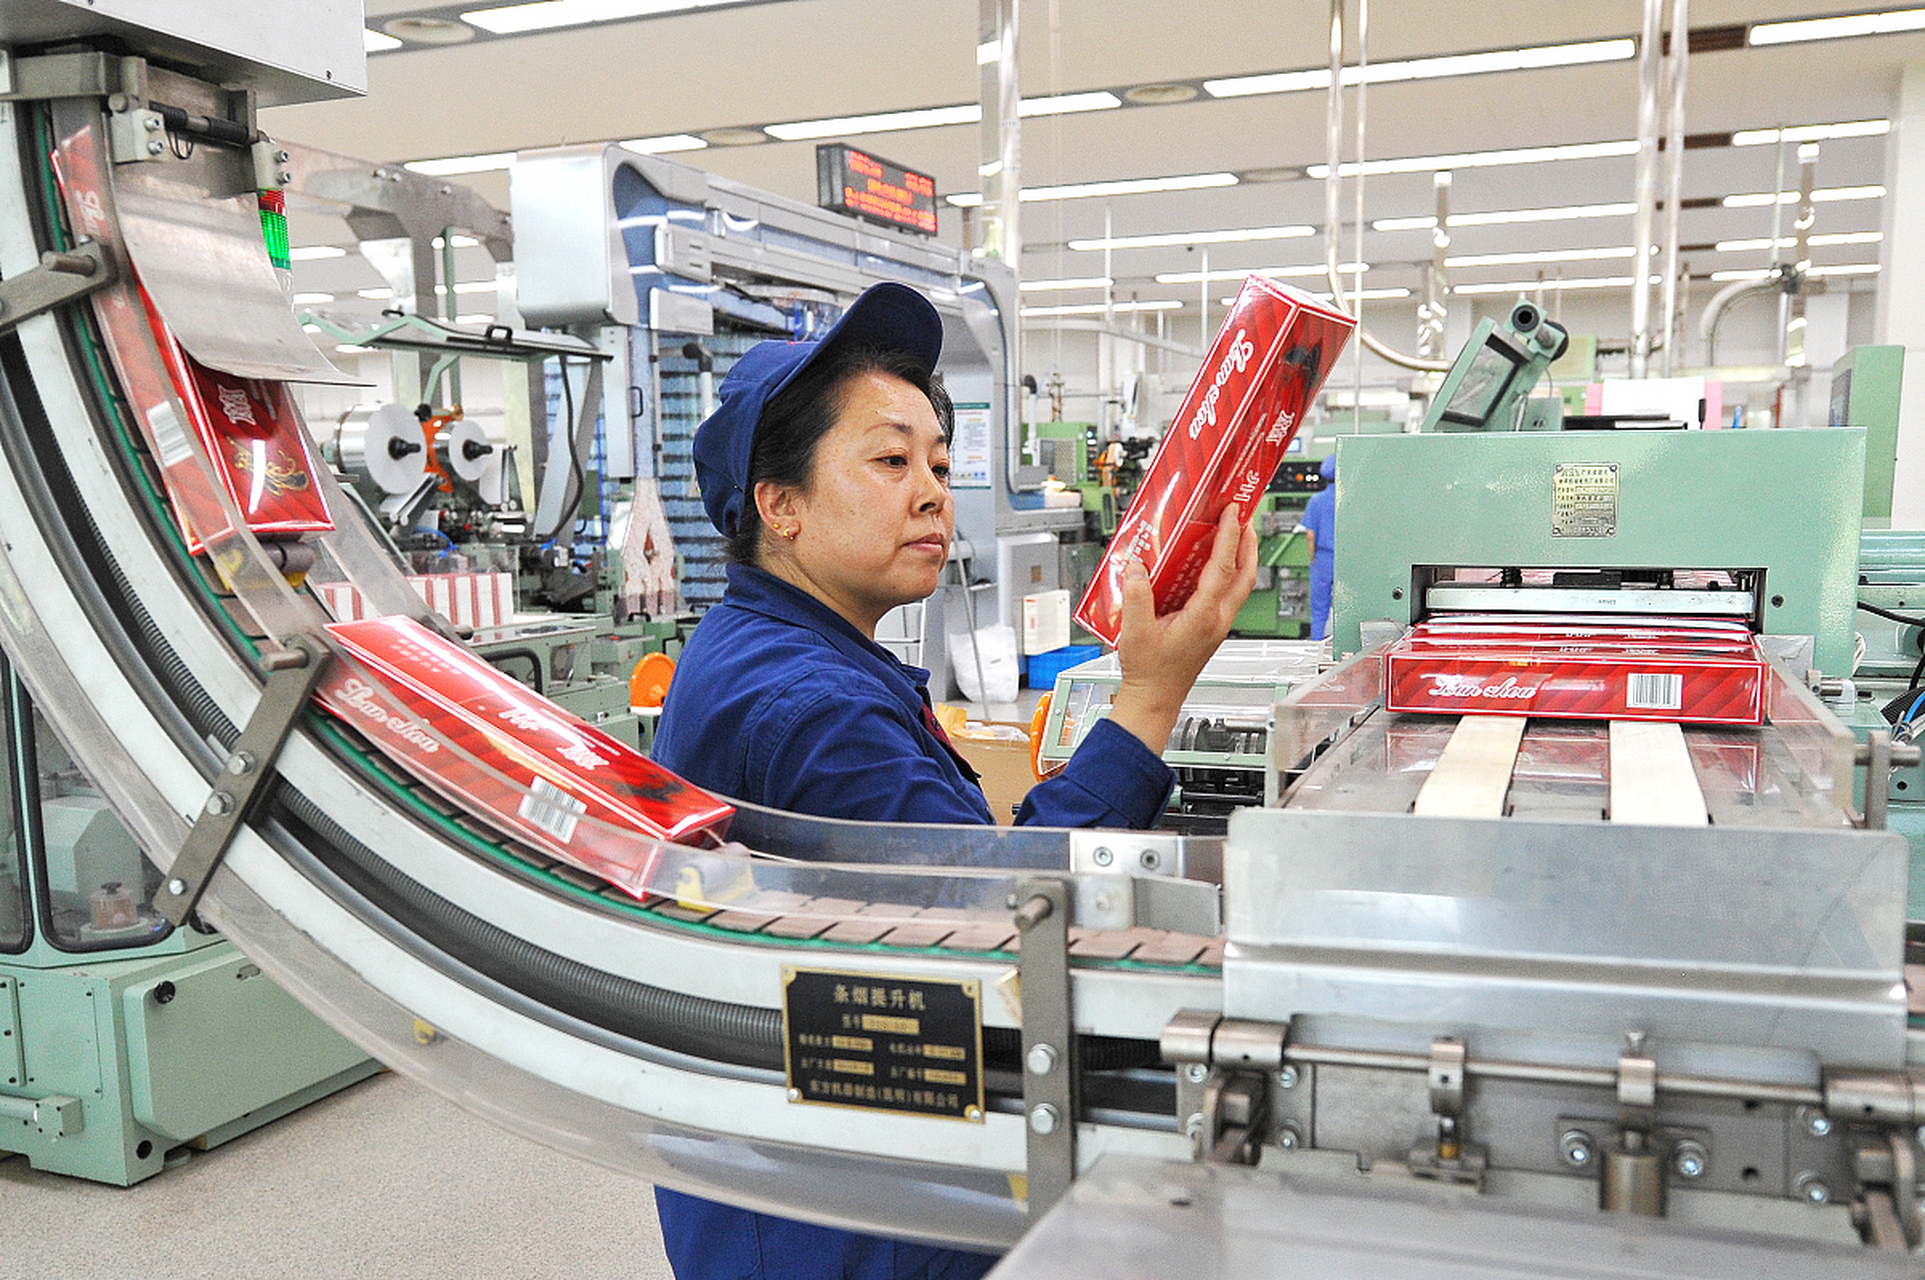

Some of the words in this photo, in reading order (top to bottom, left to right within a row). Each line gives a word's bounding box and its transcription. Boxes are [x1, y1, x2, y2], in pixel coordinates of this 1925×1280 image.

[833, 984, 925, 1010] 条烟提升机
